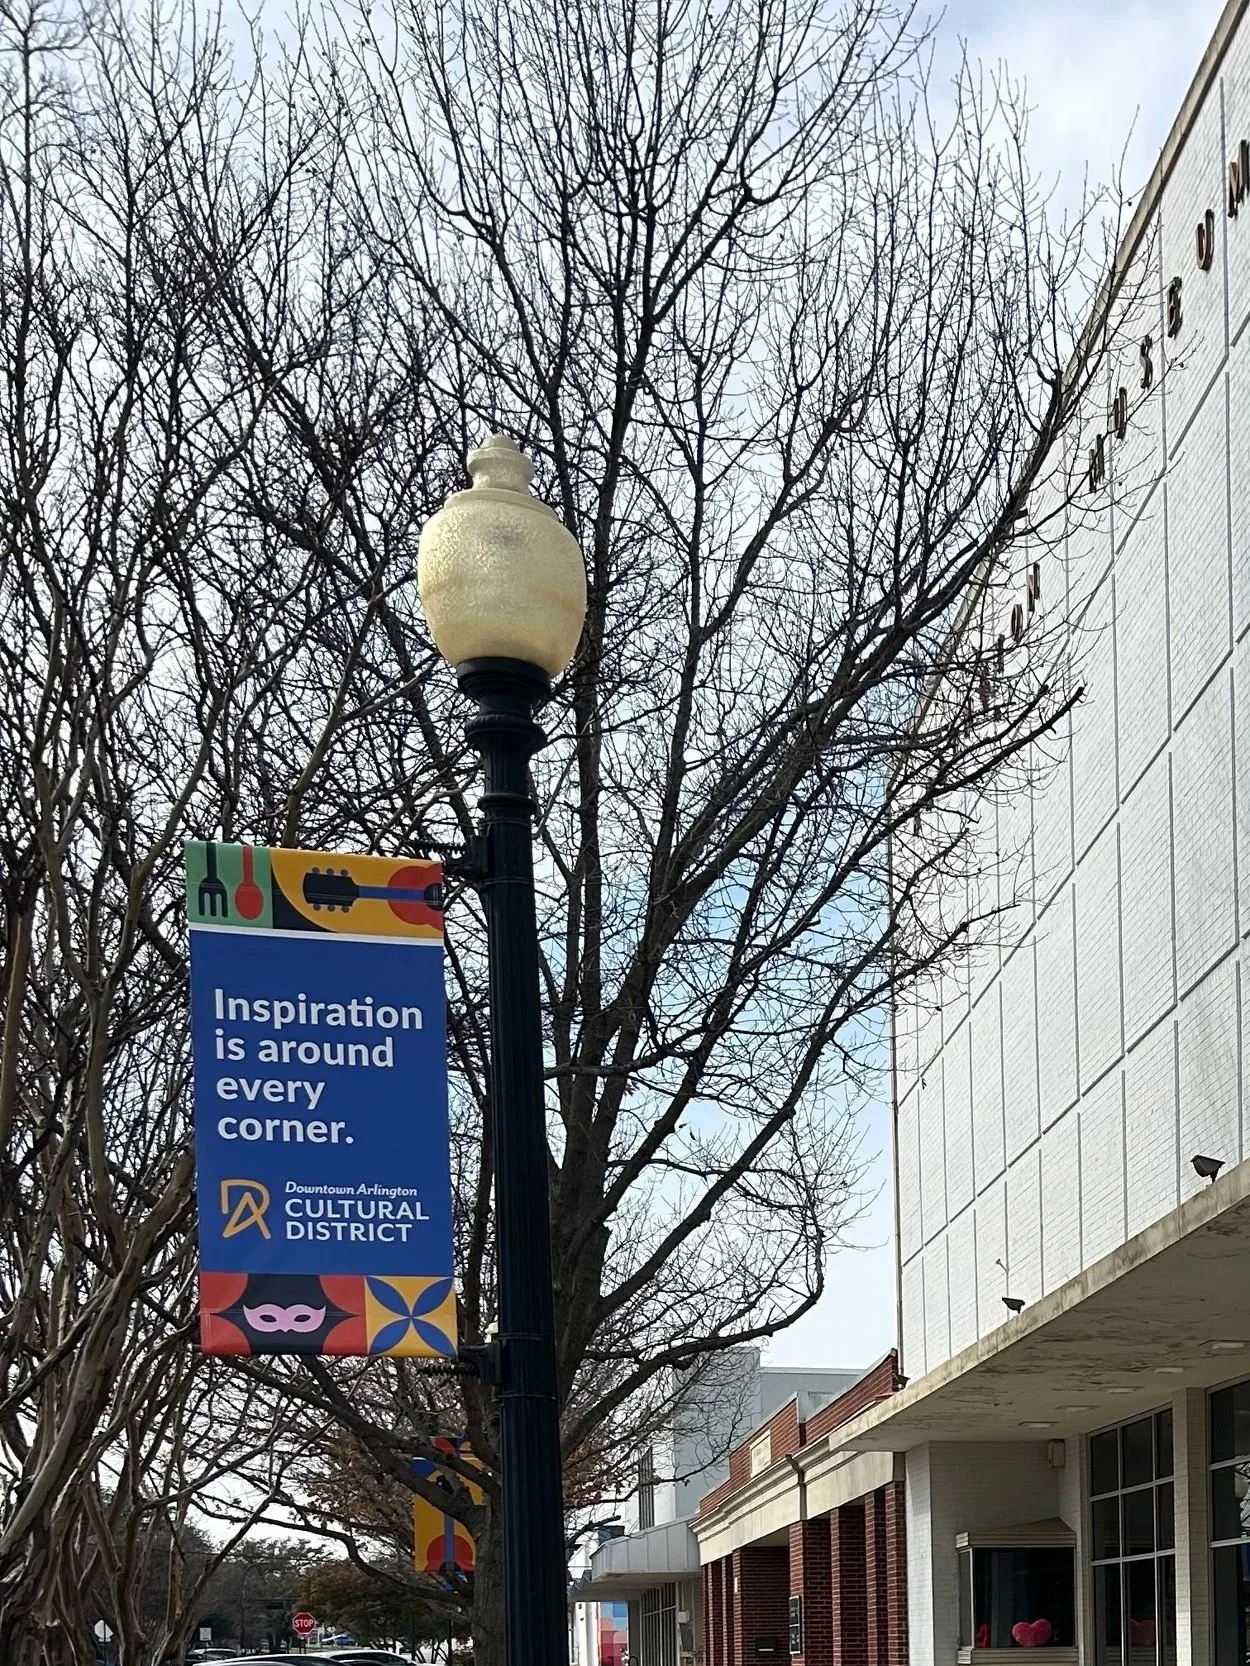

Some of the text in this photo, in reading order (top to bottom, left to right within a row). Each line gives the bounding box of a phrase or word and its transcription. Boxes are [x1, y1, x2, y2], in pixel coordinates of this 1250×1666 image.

[1089, 139, 1250, 493] MUSEUM
[214, 988, 424, 1030] Inspiration
[216, 1029, 395, 1068] is around
[216, 1076, 325, 1110] every
[217, 1113, 355, 1144] corner.
[285, 1180, 418, 1199] Downtown Arlington
[285, 1198, 430, 1221] CULTURAL
[285, 1220, 413, 1243] DISTRICT
[294, 1618, 313, 1629] STOP
